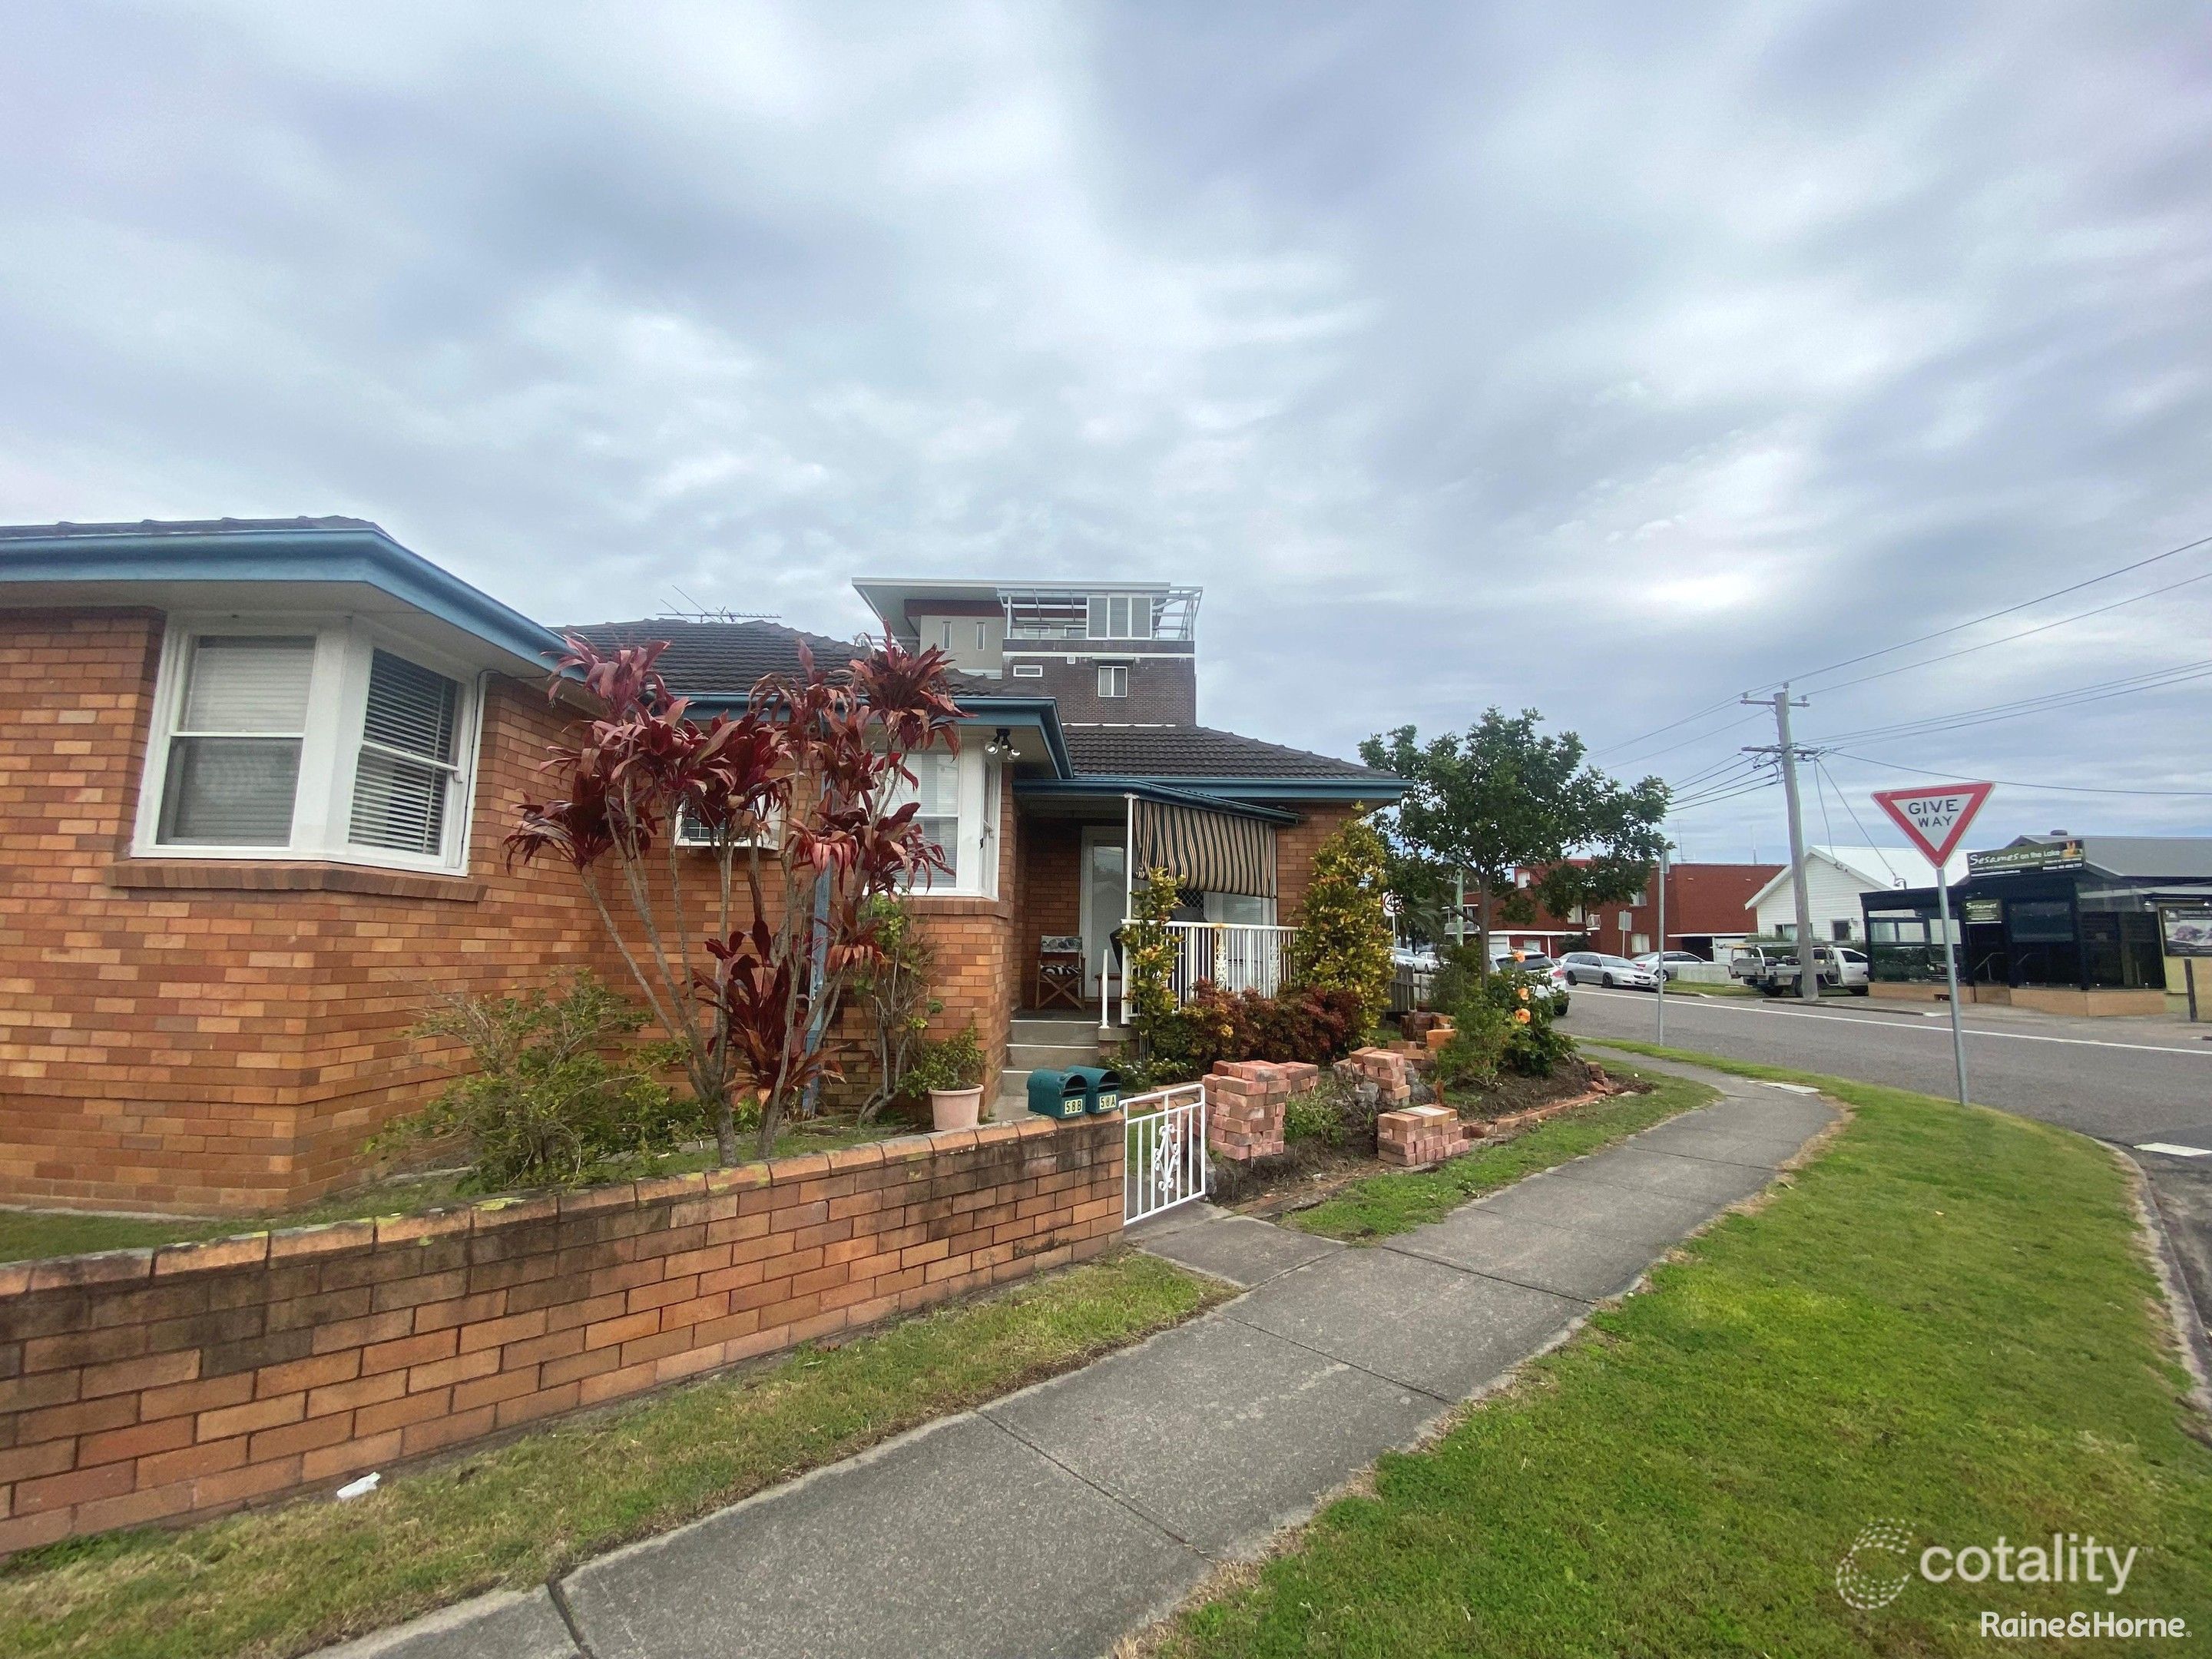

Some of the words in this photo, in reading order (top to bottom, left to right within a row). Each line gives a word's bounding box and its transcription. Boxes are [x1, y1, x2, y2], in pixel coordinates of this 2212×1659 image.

[1909, 799, 1959, 814] GIVE
[1918, 816, 1952, 827] WAY
[1969, 852, 2019, 866] Sesames
[1066, 1100, 1081, 1112] 58B
[1101, 1096, 1115, 1108] 58A
